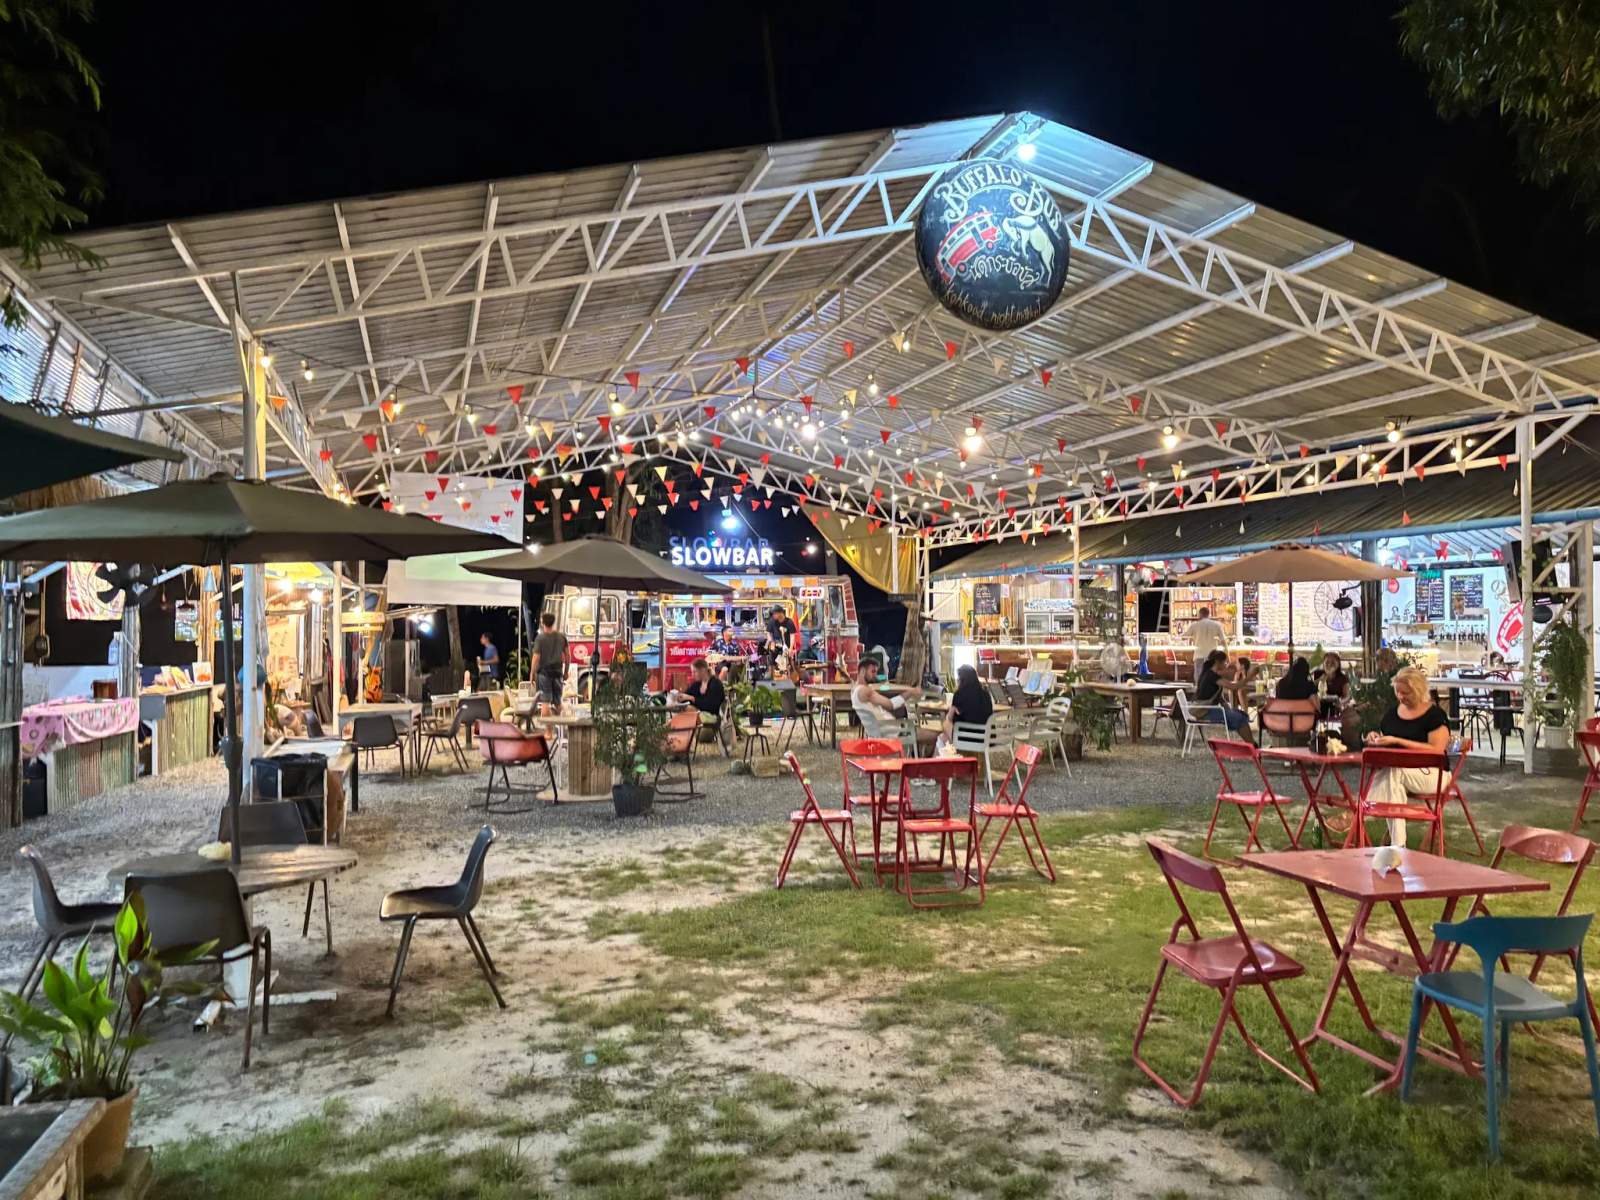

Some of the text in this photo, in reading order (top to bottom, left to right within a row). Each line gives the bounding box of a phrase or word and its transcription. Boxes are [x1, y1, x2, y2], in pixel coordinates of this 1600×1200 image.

[934, 164, 1062, 231] BUFFALO BUS
[671, 546, 774, 566] SLOWBAR
